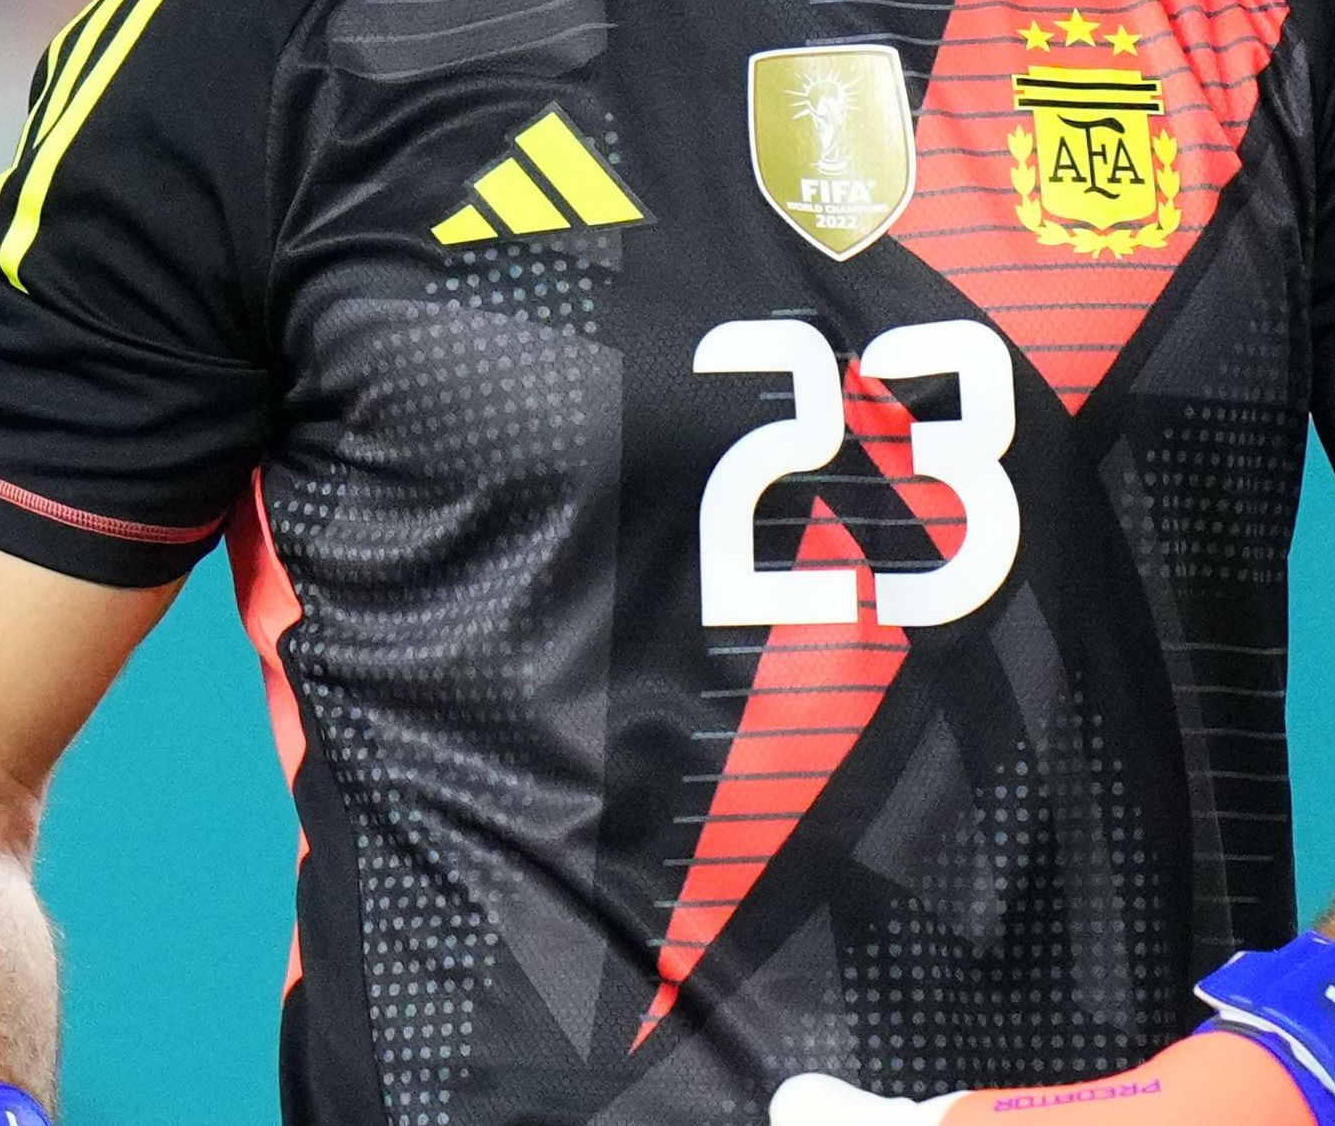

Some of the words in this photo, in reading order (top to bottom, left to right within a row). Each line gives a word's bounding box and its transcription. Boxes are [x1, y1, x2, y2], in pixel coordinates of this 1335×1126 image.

[1048, 113, 1146, 200] AFA
[786, 201, 823, 213] WORLD
[815, 214, 858, 229] 2022
[693, 319, 1021, 627] 23
[993, 1078, 1162, 1112] PREDATOR
